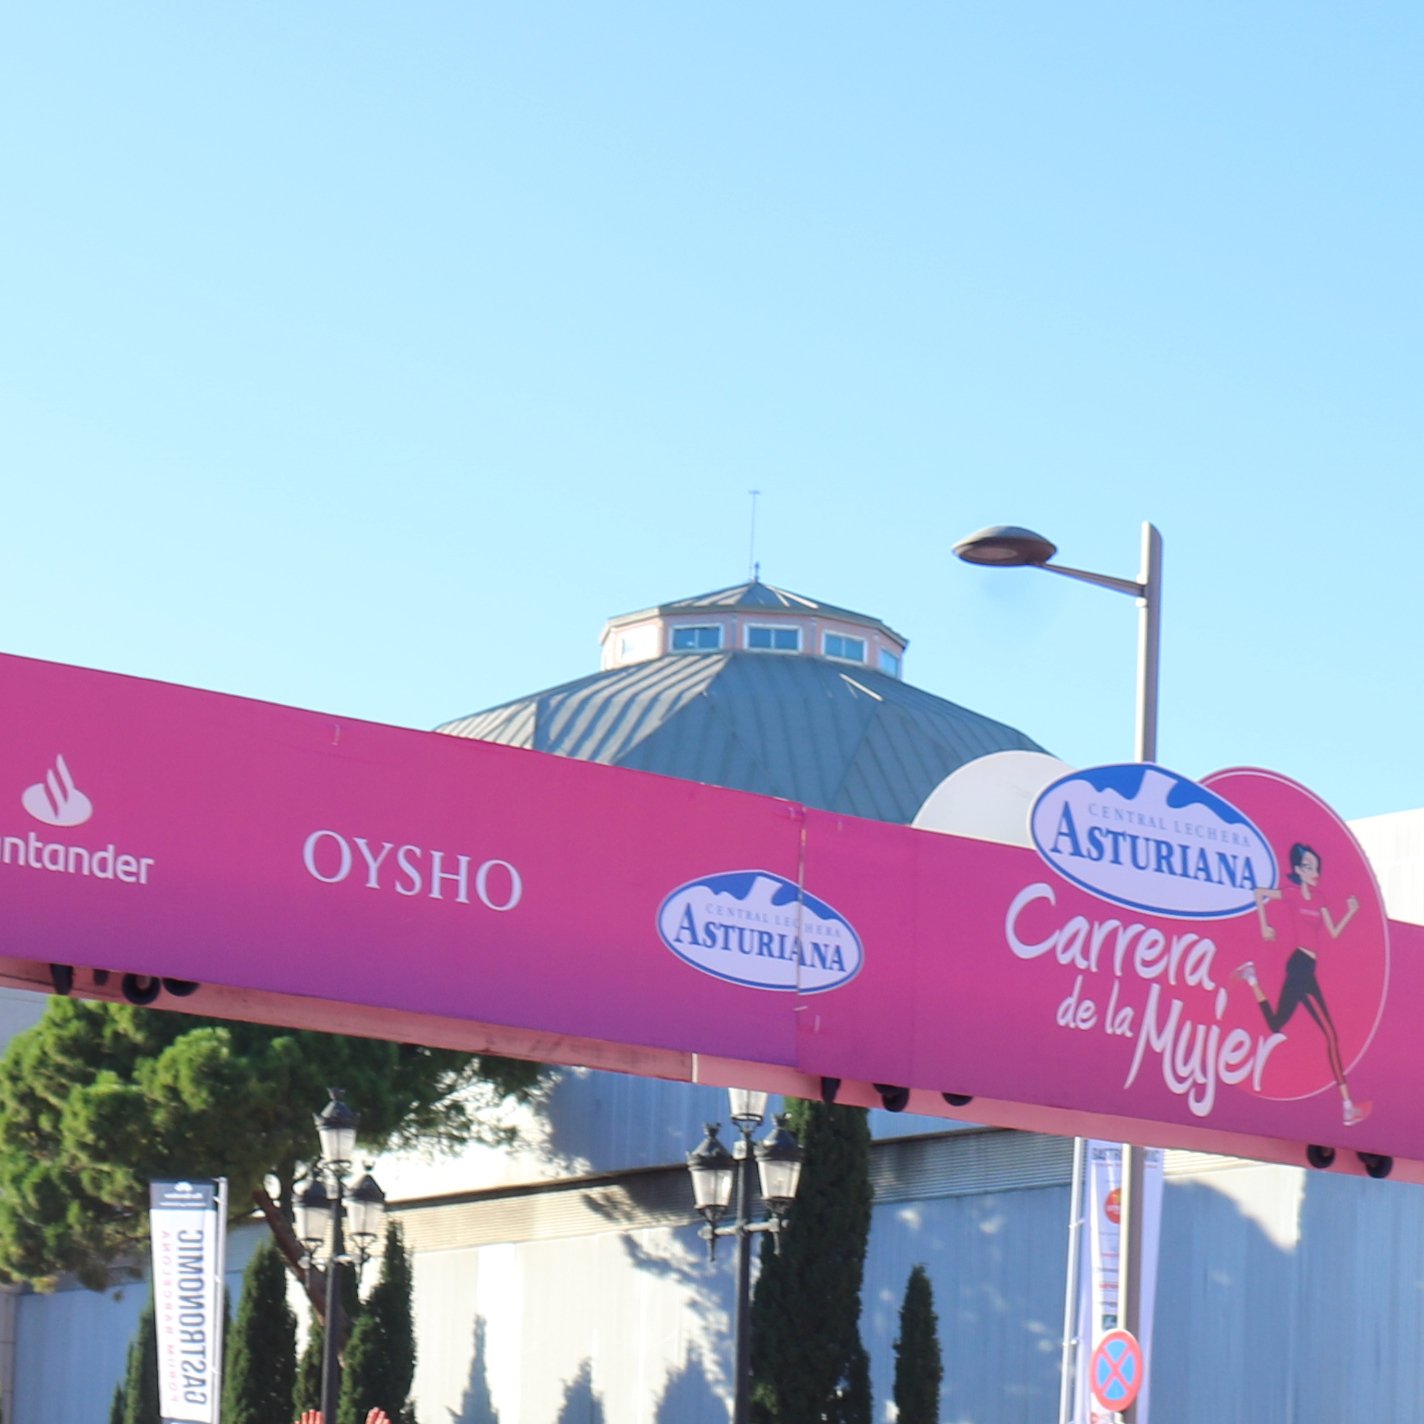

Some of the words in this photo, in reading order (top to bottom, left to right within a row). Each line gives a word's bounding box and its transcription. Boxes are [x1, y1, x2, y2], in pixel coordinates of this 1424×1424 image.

[1050, 800, 1258, 892] ASTURIANA
[1088, 802, 1167, 831] CENTRAL
[1175, 819, 1251, 847] LECHERA
[302, 829, 523, 911] OYSHO
[673, 902, 847, 972] ASTURIANA
[705, 902, 769, 924] CENTRAL
[1005, 882, 1217, 990] Carrera
[1056, 974, 1098, 1031] de
[1105, 980, 1134, 1038] la
[1123, 983, 1287, 1117] Mujer
